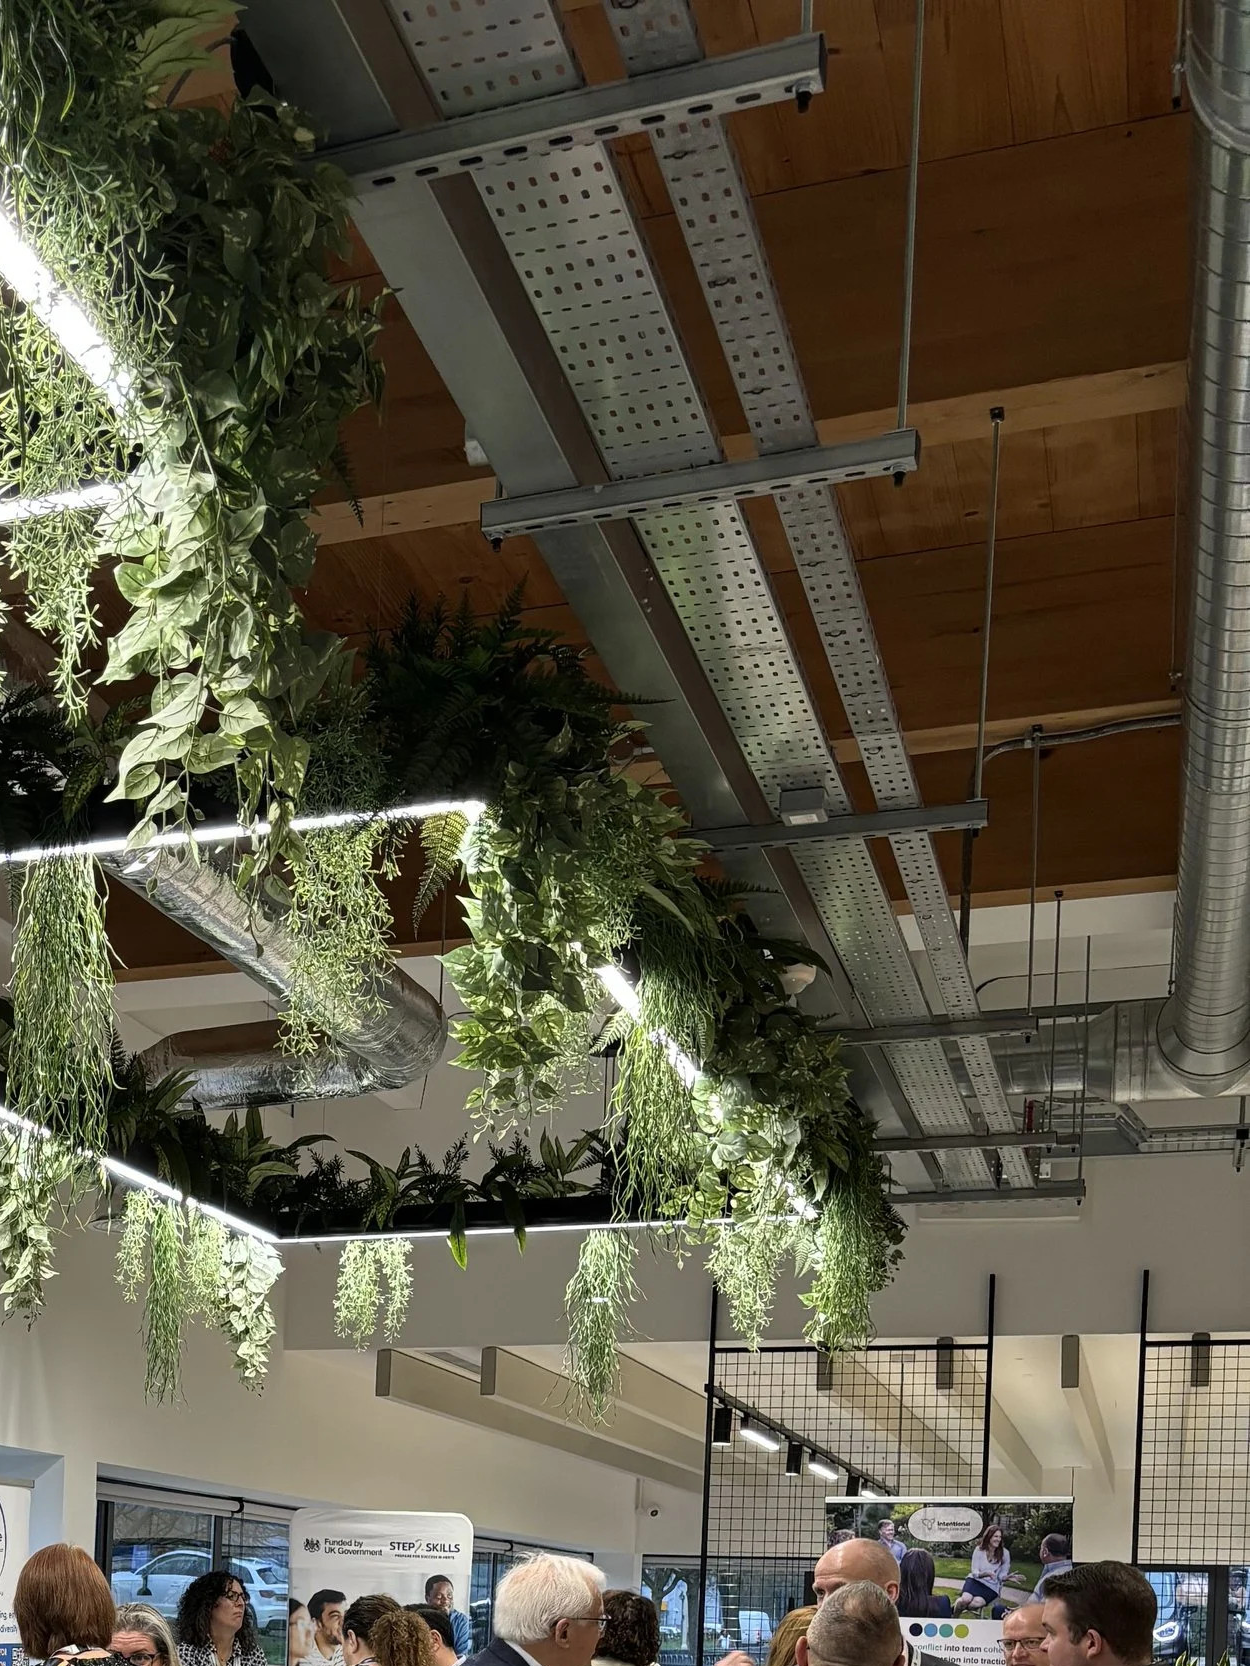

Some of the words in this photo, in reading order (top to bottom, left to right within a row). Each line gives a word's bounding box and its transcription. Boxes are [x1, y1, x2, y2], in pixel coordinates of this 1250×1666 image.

[324, 1538, 352, 1547] Funded
[353, 1538, 364, 1549] by
[324, 1547, 336, 1555] UK
[338, 1548, 383, 1556] Government
[944, 1644, 960, 1652] into
[962, 1645, 982, 1653] team
[980, 1657, 1006, 1666] tractio
